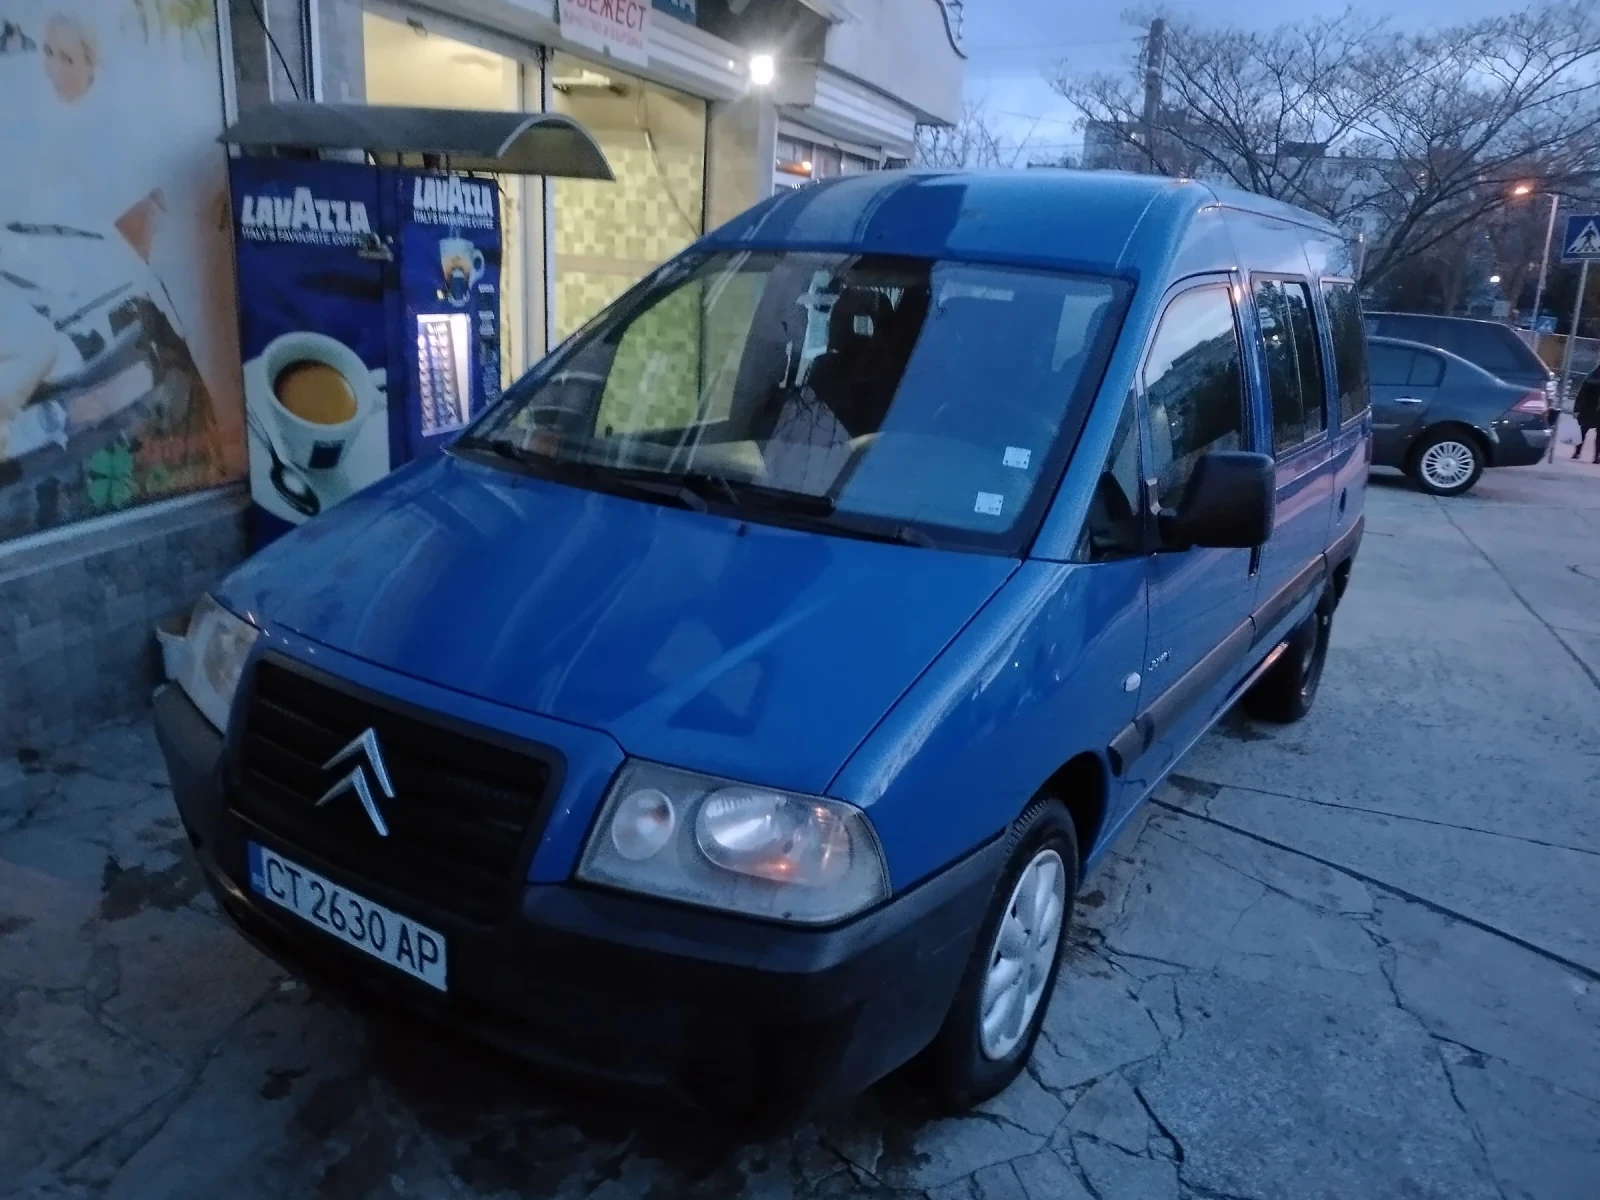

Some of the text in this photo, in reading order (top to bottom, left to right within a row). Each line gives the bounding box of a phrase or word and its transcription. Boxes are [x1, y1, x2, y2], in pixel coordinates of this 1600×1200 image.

[566, 0, 647, 32] ЕЖЕСТ
[241, 186, 371, 234] LAVAZZA
[413, 175, 494, 217] LAVAZZA
[266, 858, 439, 974] CT 2630 AP
